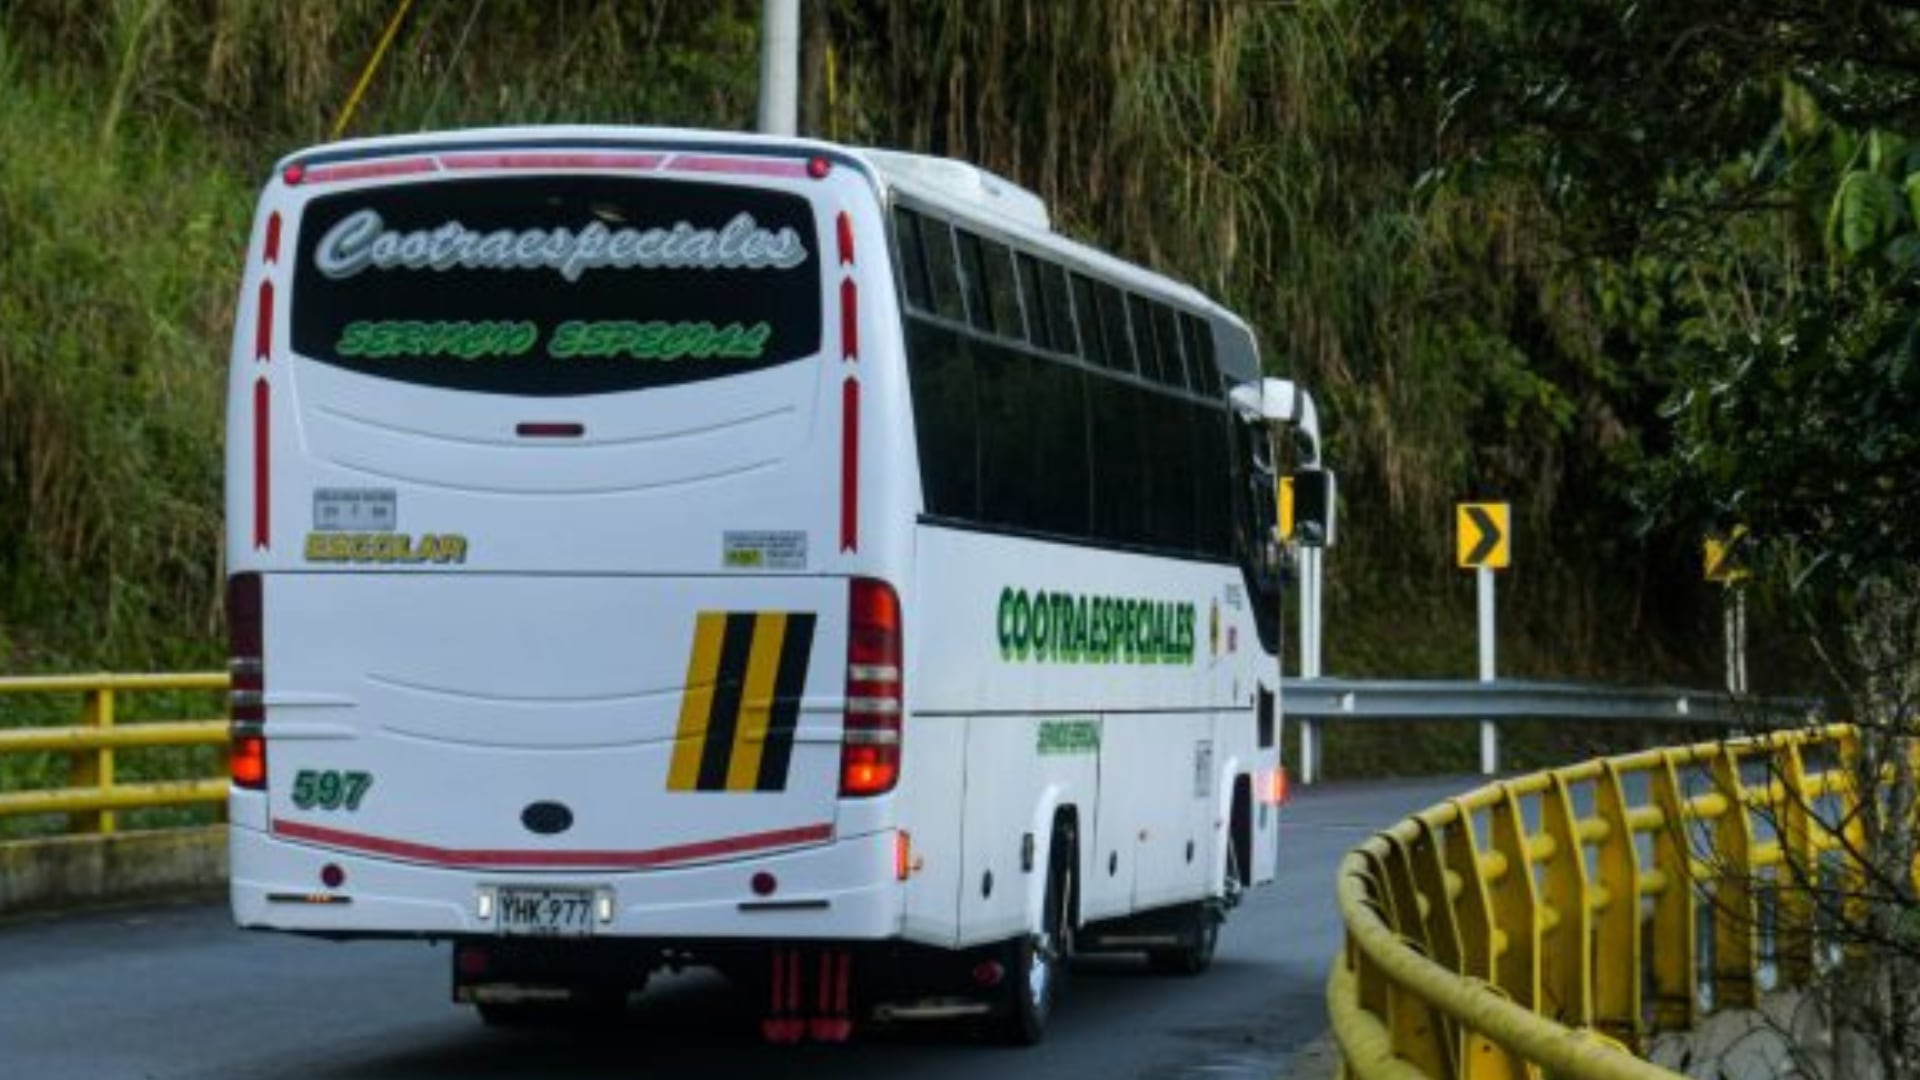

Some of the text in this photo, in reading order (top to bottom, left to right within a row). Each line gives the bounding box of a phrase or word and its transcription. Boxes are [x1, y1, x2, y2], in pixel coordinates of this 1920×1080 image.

[316, 209, 806, 281] Cootraespeciales
[337, 321, 769, 360] SERVICIO ESPECIAL
[305, 532, 467, 564] ESCOLAR
[998, 586, 1195, 663] COOTRAESPECIALES
[292, 770, 372, 809] 597
